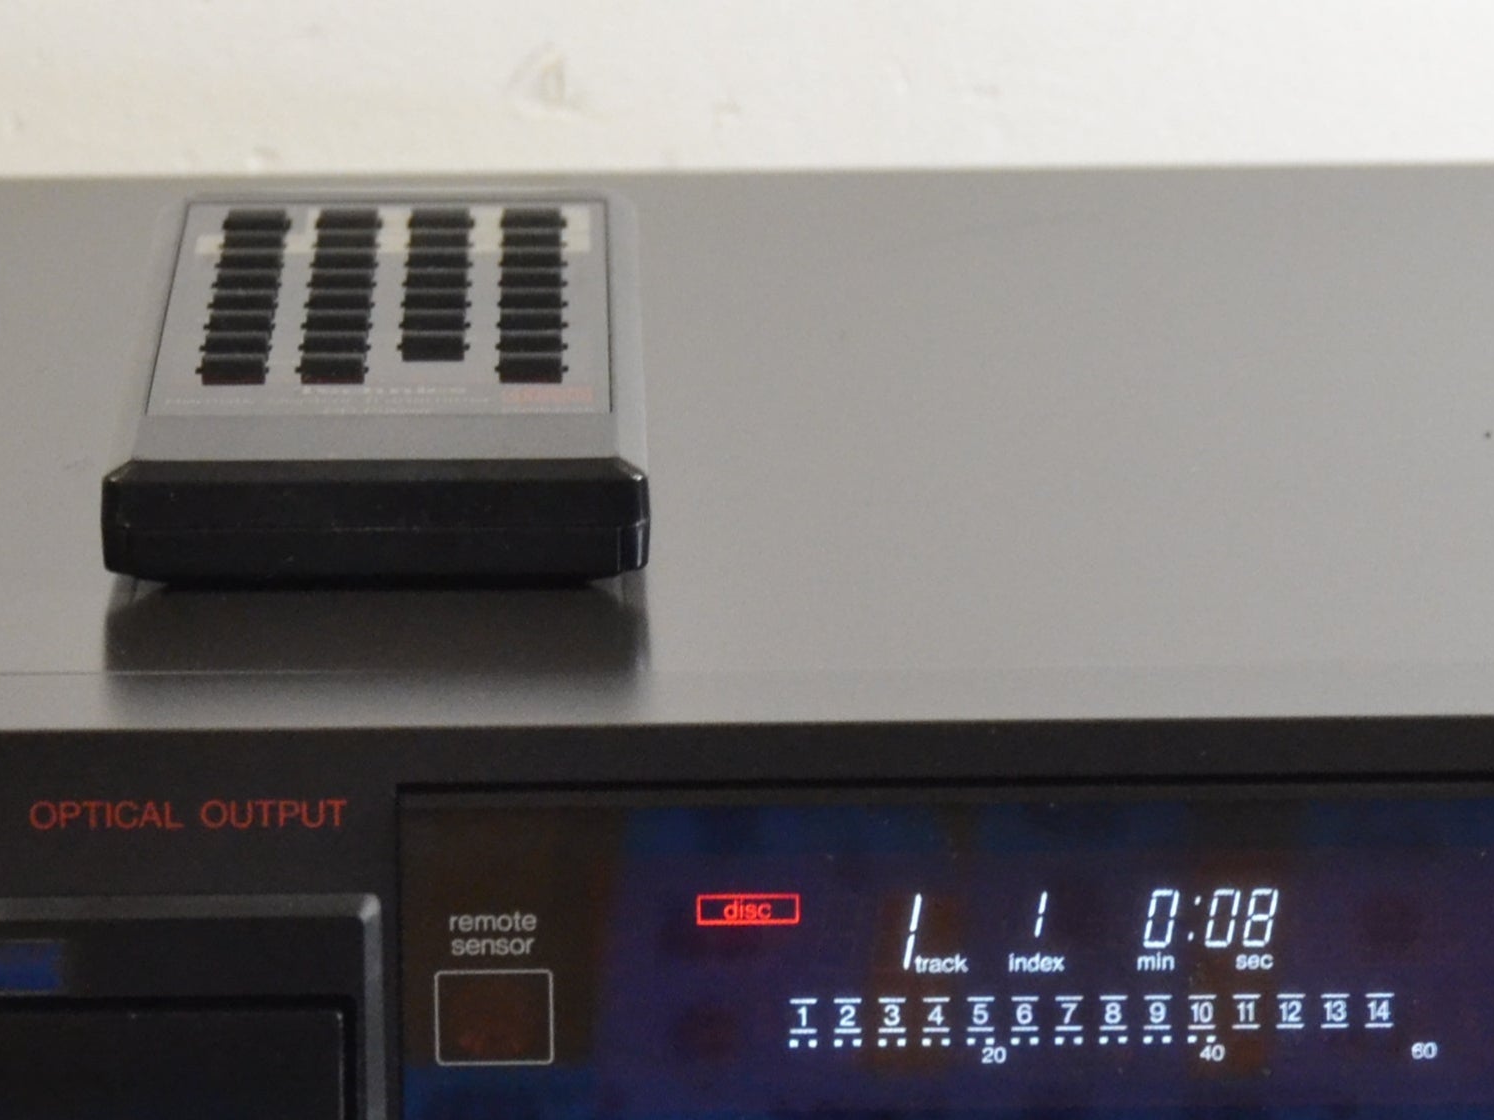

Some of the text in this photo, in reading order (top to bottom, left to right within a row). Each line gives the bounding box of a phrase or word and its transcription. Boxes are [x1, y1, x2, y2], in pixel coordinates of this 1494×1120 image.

[29, 798, 348, 830] OPTICAL OUTPUT
[723, 900, 771, 921] disc
[1143, 889, 1279, 948] 0:08
[449, 912, 537, 933] remote
[451, 936, 535, 956] sensor
[915, 953, 968, 974] track
[1008, 952, 1065, 973] index
[1137, 953, 1175, 972] min
[1235, 955, 1274, 971] sec
[797, 1001, 1390, 1027] 1 2 3 4 5 6 7 8 9 10 11 12 13 14
[982, 1047, 1006, 1064] 20
[1201, 1045, 1225, 1062] 40
[1412, 1042, 1437, 1059] 60
